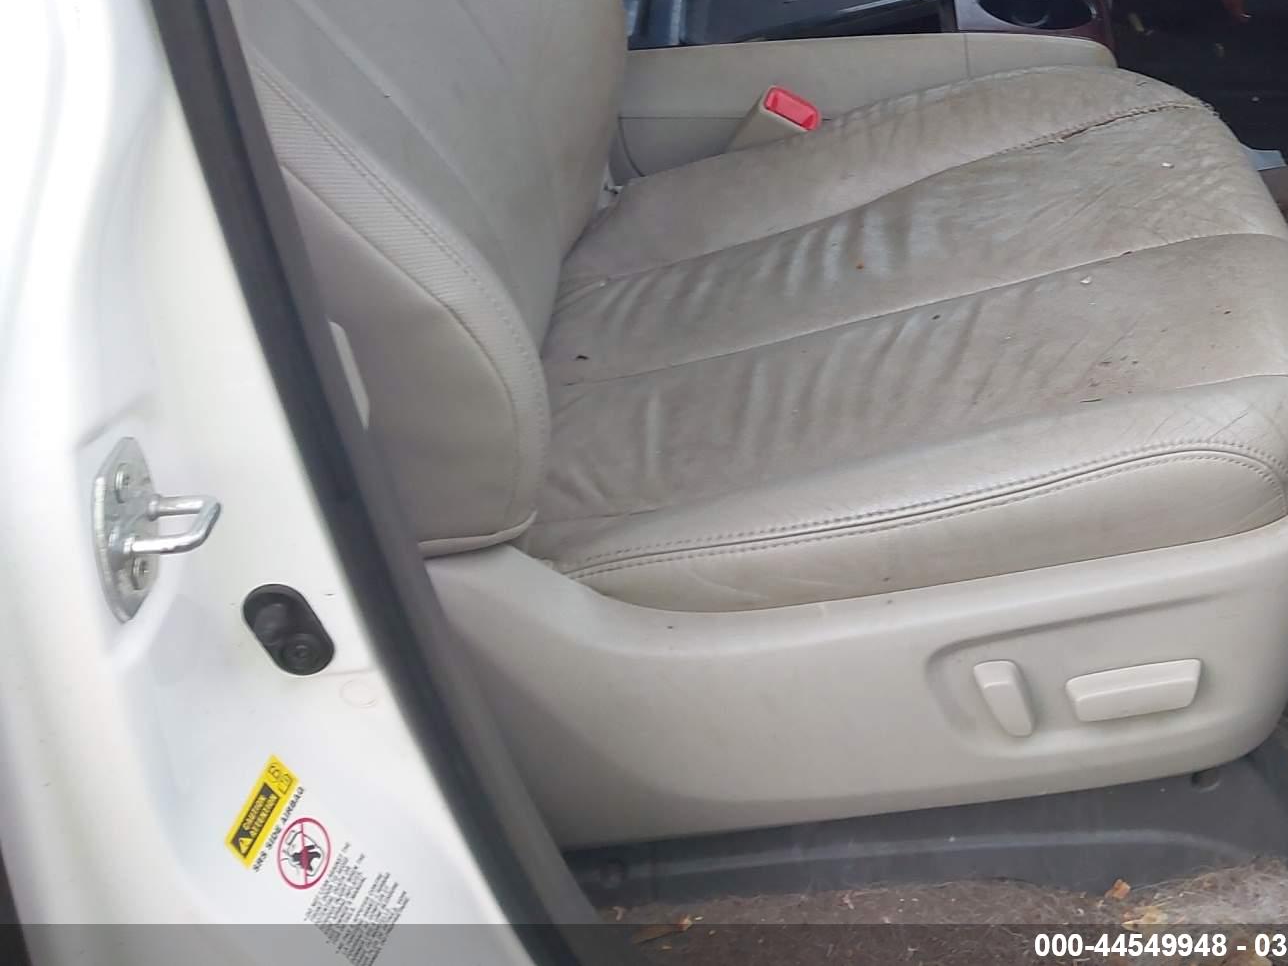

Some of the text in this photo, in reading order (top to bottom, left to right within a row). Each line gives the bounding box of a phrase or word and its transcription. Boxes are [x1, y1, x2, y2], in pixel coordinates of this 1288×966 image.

[242, 794, 267, 831] CAUTION
[266, 826, 282, 850] SIDE
[281, 786, 305, 824] AIRBAG
